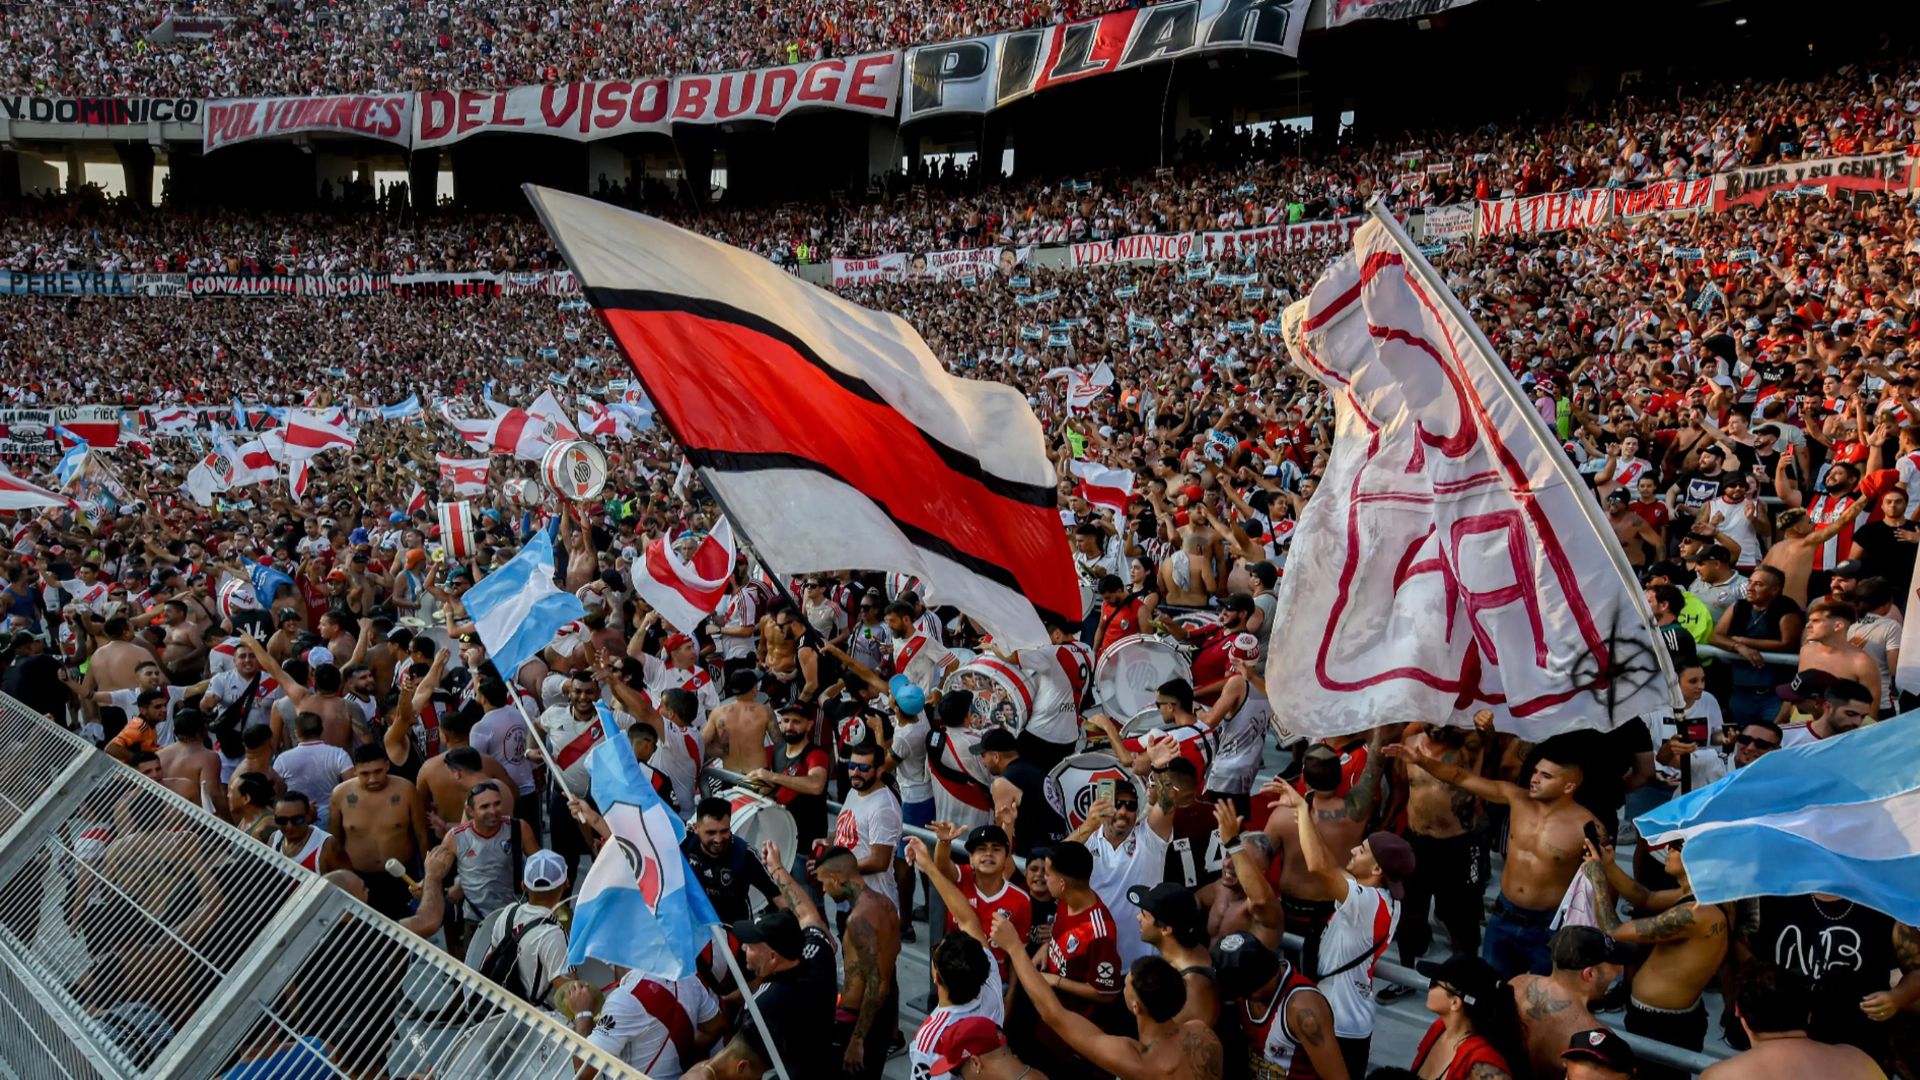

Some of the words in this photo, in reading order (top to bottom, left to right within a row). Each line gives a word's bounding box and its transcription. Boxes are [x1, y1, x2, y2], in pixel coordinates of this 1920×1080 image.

[420, 91, 526, 141] DEL
[540, 79, 670, 133] VISO
[671, 53, 894, 119] BUDGE
[207, 97, 405, 147] POLVORINES
[1613, 177, 1712, 218] VARELA
[1726, 169, 1789, 200] RIVER
[1809, 163, 1832, 178] SU
[1838, 154, 1905, 184] GENTE
[1479, 189, 1610, 239] MATHEU
[11, 273, 124, 294] PEREYRA
